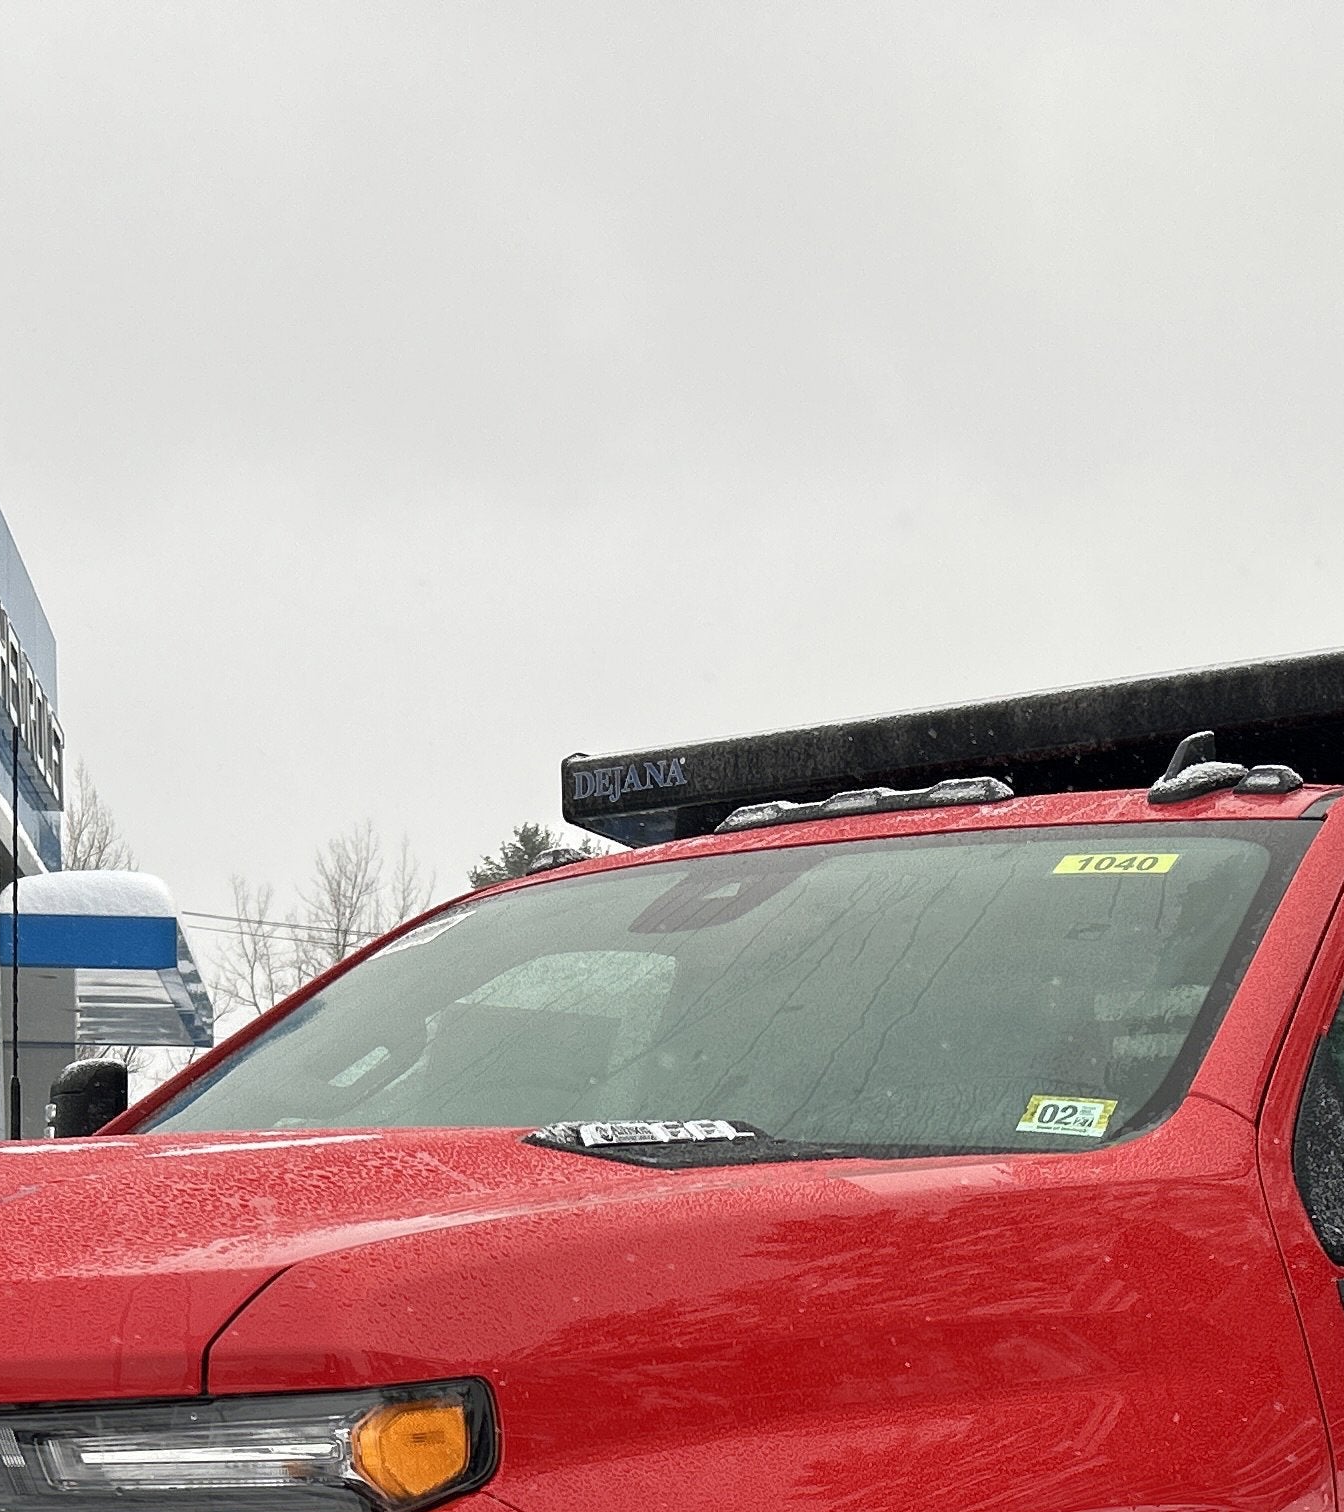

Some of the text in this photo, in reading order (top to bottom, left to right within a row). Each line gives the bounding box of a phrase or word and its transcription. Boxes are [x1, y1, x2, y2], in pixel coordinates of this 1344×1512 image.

[573, 757, 687, 803] DEJANA
[1077, 856, 1158, 872] 1040
[1037, 1104, 1078, 1125] 02
